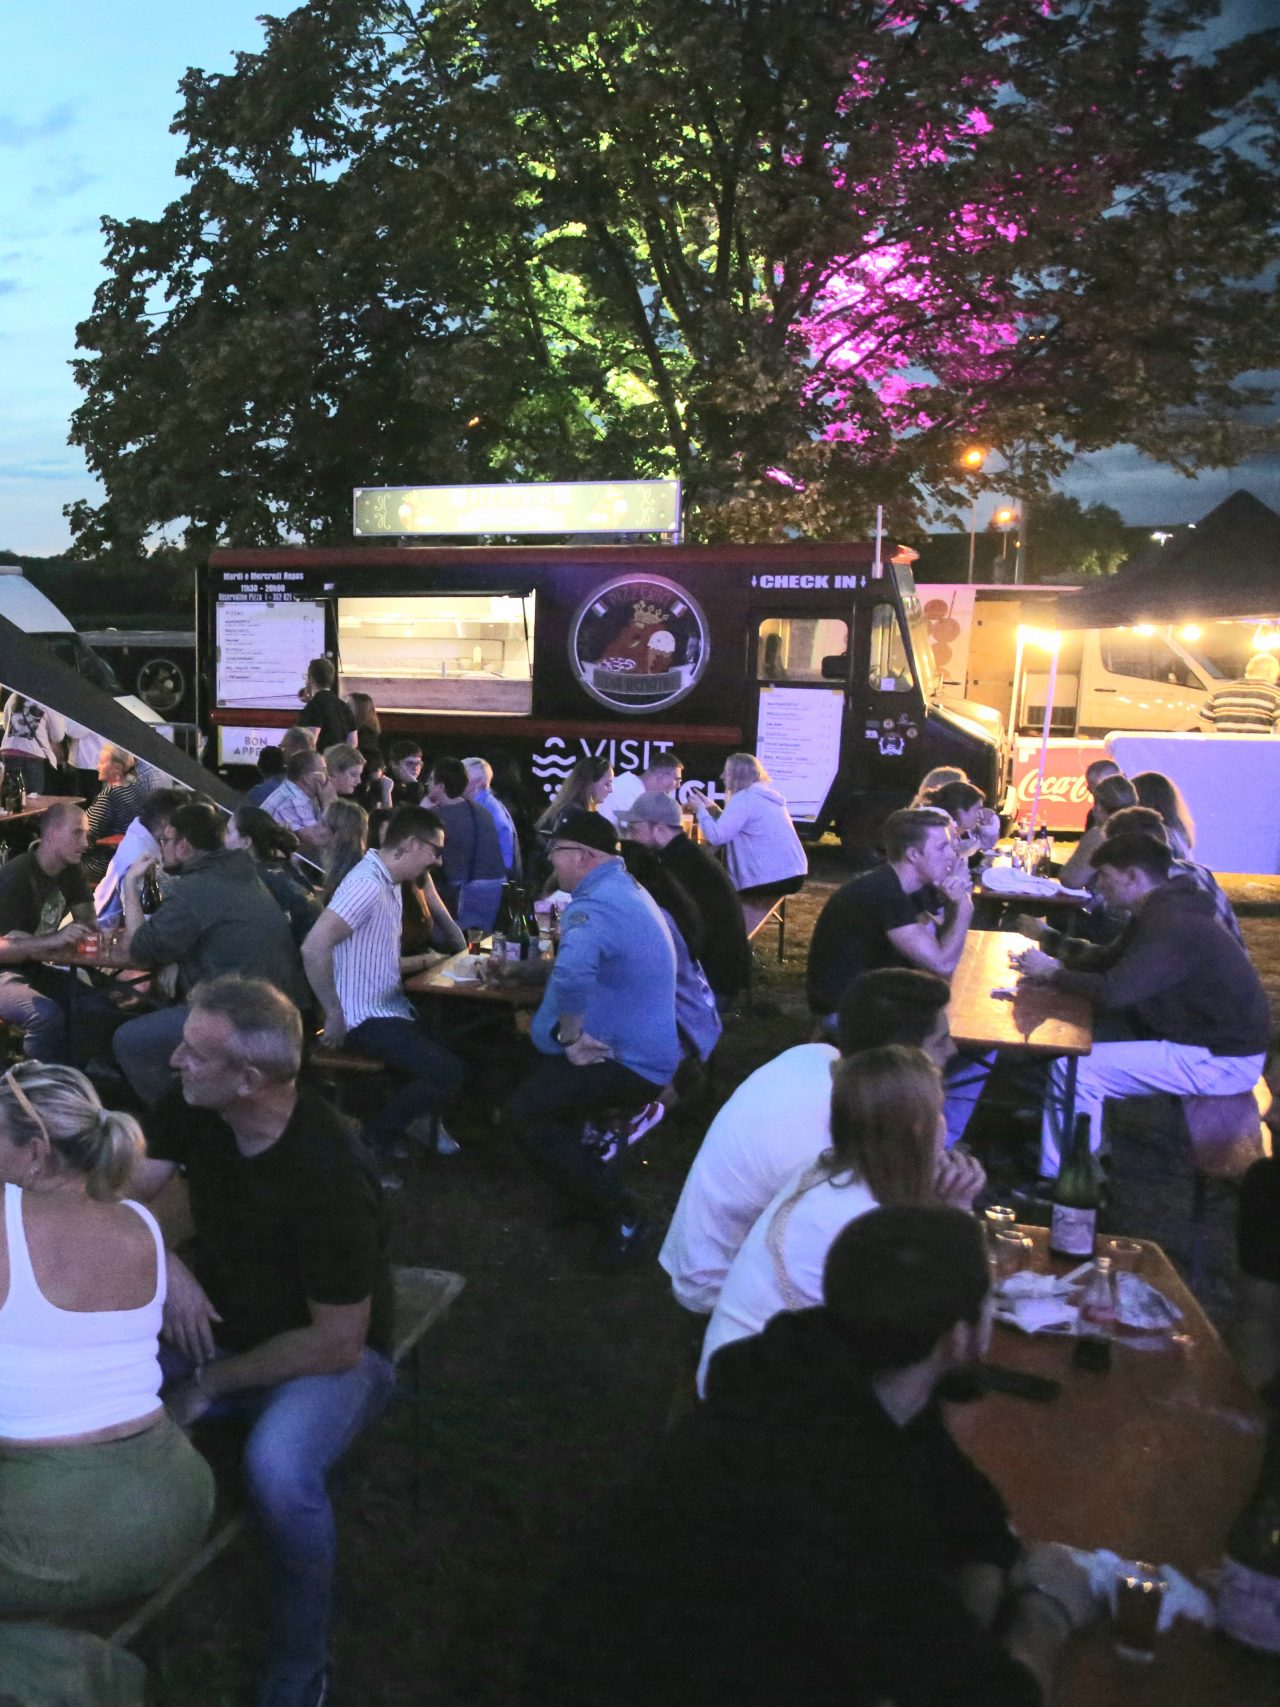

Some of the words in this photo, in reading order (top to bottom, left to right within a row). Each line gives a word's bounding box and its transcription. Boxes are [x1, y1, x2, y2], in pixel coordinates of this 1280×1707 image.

[760, 575, 829, 589] CHECK
[834, 575, 857, 589] IN
[244, 736, 268, 746] BON
[233, 747, 261, 756] APPE
[579, 738, 674, 770] VISIT
